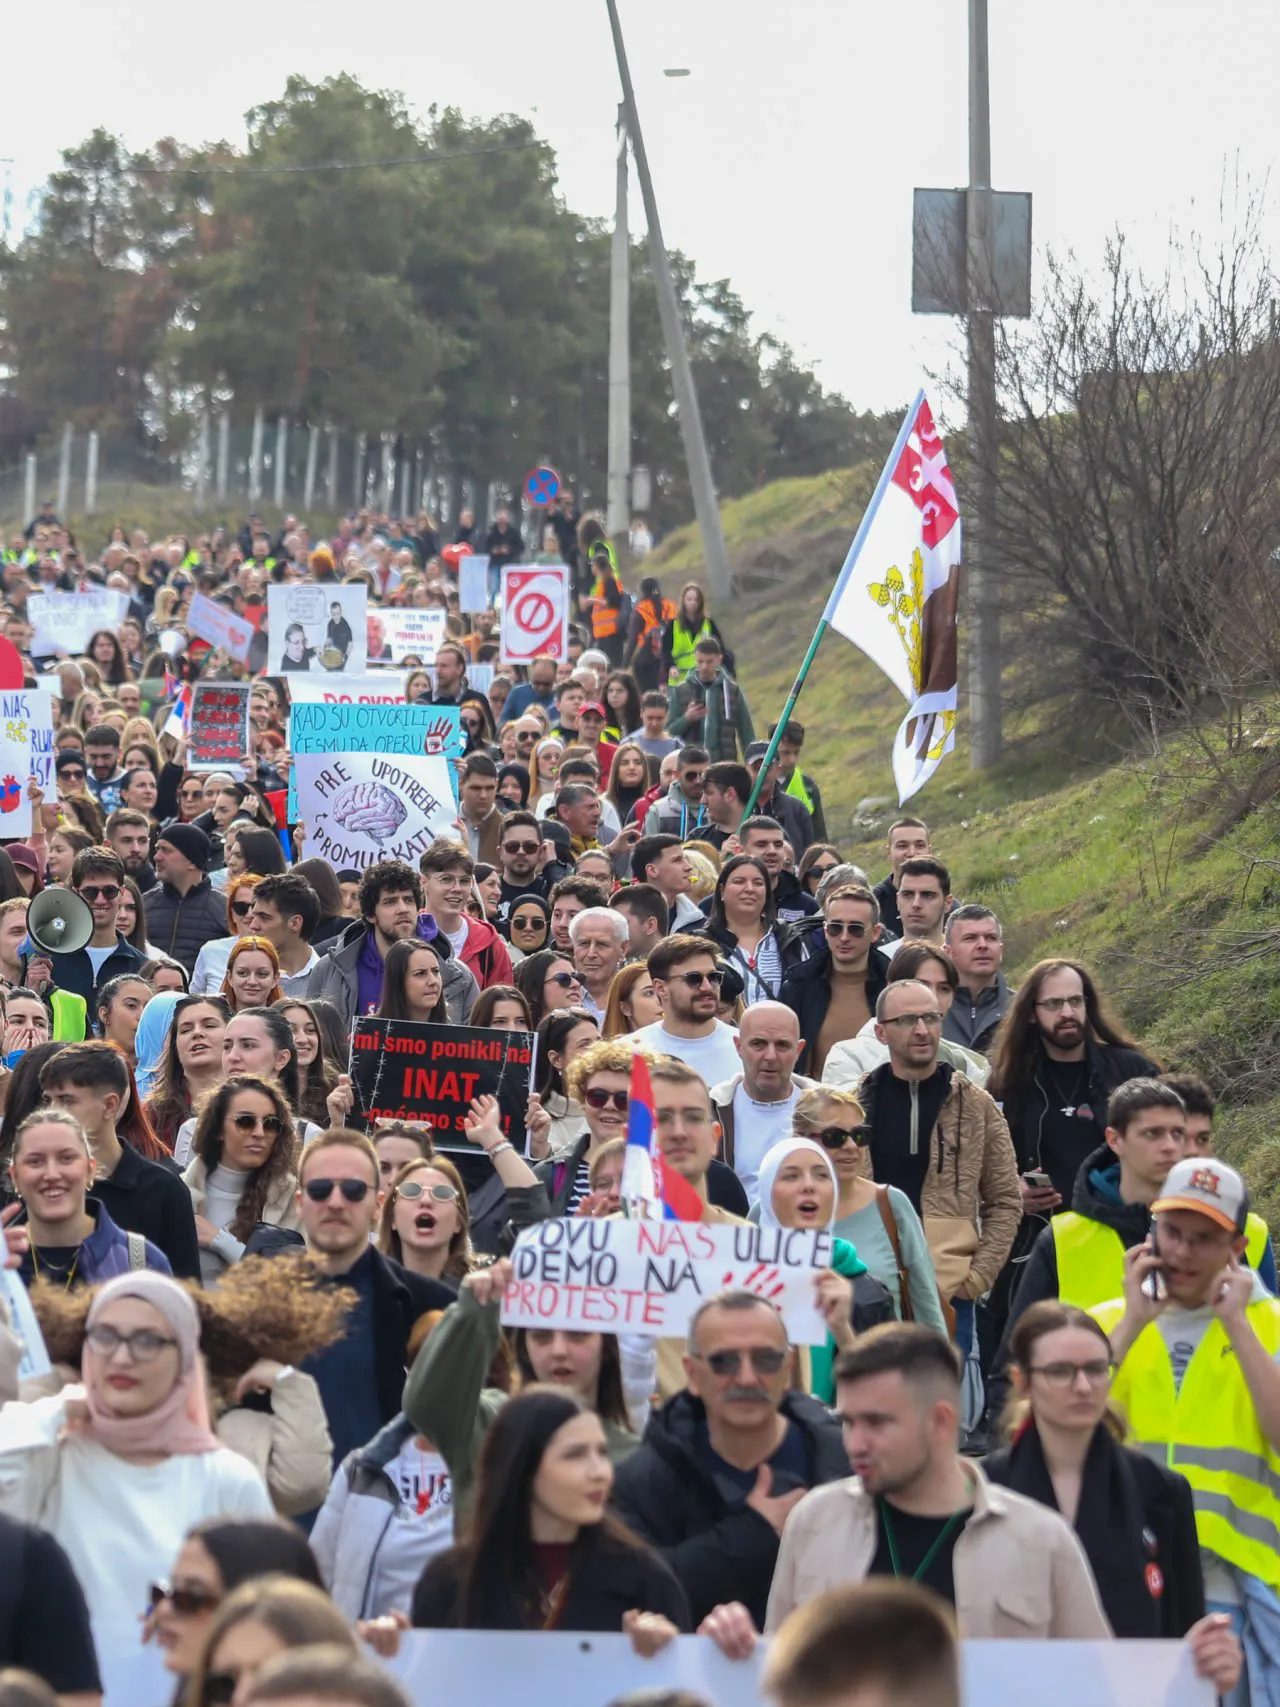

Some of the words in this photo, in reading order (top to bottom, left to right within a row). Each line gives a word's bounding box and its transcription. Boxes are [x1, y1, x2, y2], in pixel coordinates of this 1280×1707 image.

[293, 705, 327, 732] KAD
[330, 706, 350, 732] SU
[356, 707, 429, 732] OTVORILI
[375, 734, 422, 754] OPERU
[313, 760, 353, 799] PRE
[370, 757, 442, 820] UPOTREBE
[384, 1037, 427, 1056] smo
[431, 1040, 502, 1062] ponikli
[506, 1047, 531, 1065] na
[402, 1066, 481, 1104] INAT
[637, 1221, 716, 1260] NAS
[733, 1227, 831, 1269] ULICE
[643, 1256, 703, 1295] NA
[502, 1281, 666, 1326] PROTESTE
